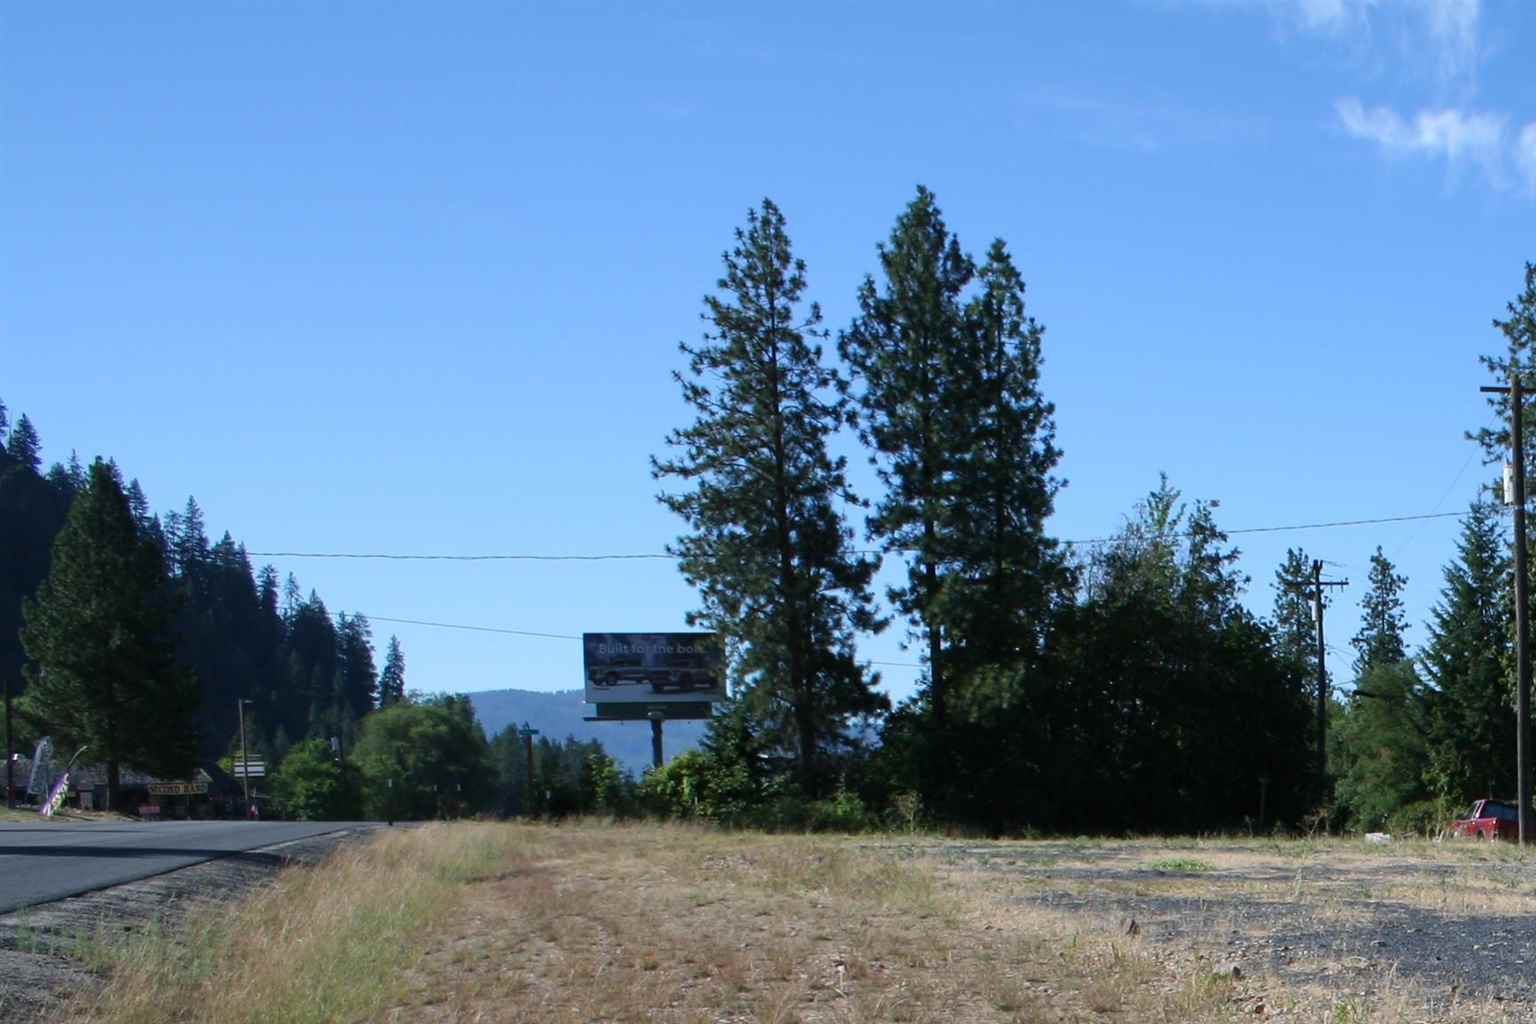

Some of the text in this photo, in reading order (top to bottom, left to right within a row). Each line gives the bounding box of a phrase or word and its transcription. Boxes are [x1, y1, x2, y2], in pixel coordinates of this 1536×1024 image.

[599, 643, 704, 654] Built for the bol
